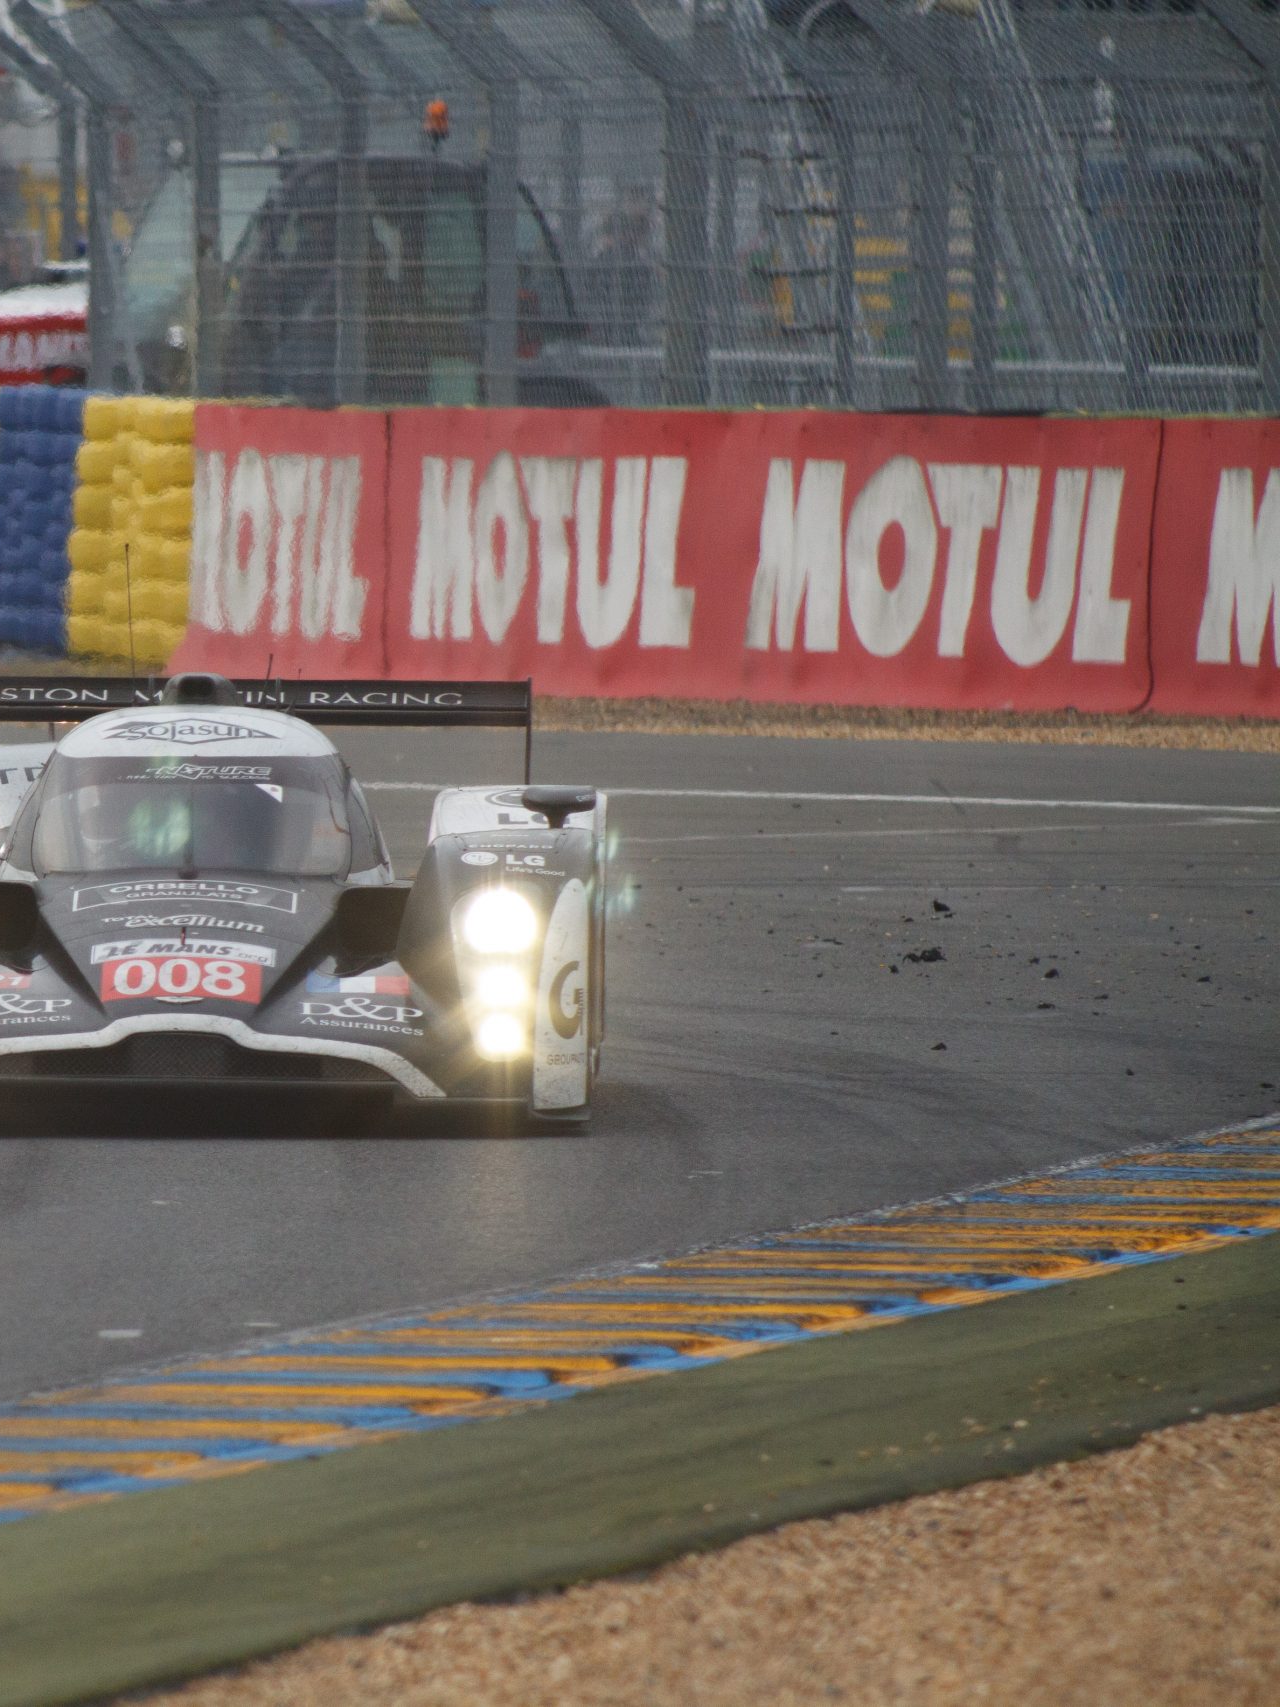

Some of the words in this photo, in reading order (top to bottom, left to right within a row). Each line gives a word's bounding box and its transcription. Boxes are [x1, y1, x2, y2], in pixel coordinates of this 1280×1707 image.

[189, 448, 369, 640] MOTUL
[409, 448, 695, 650] MOTUL
[743, 455, 1131, 668] MOTUL
[309, 691, 463, 705] RACING
[125, 722, 254, 740] sojasun
[505, 854, 545, 866] LG
[505, 866, 533, 874] Life's
[535, 868, 566, 877] Good
[109, 882, 260, 895] ORBELLO
[125, 890, 244, 899] GRANULATS
[124, 914, 265, 933] excellium
[145, 943, 234, 957] MANS
[113, 958, 247, 996] 008
[299, 997, 424, 1023] D&P
[299, 1016, 424, 1036] Assurances
